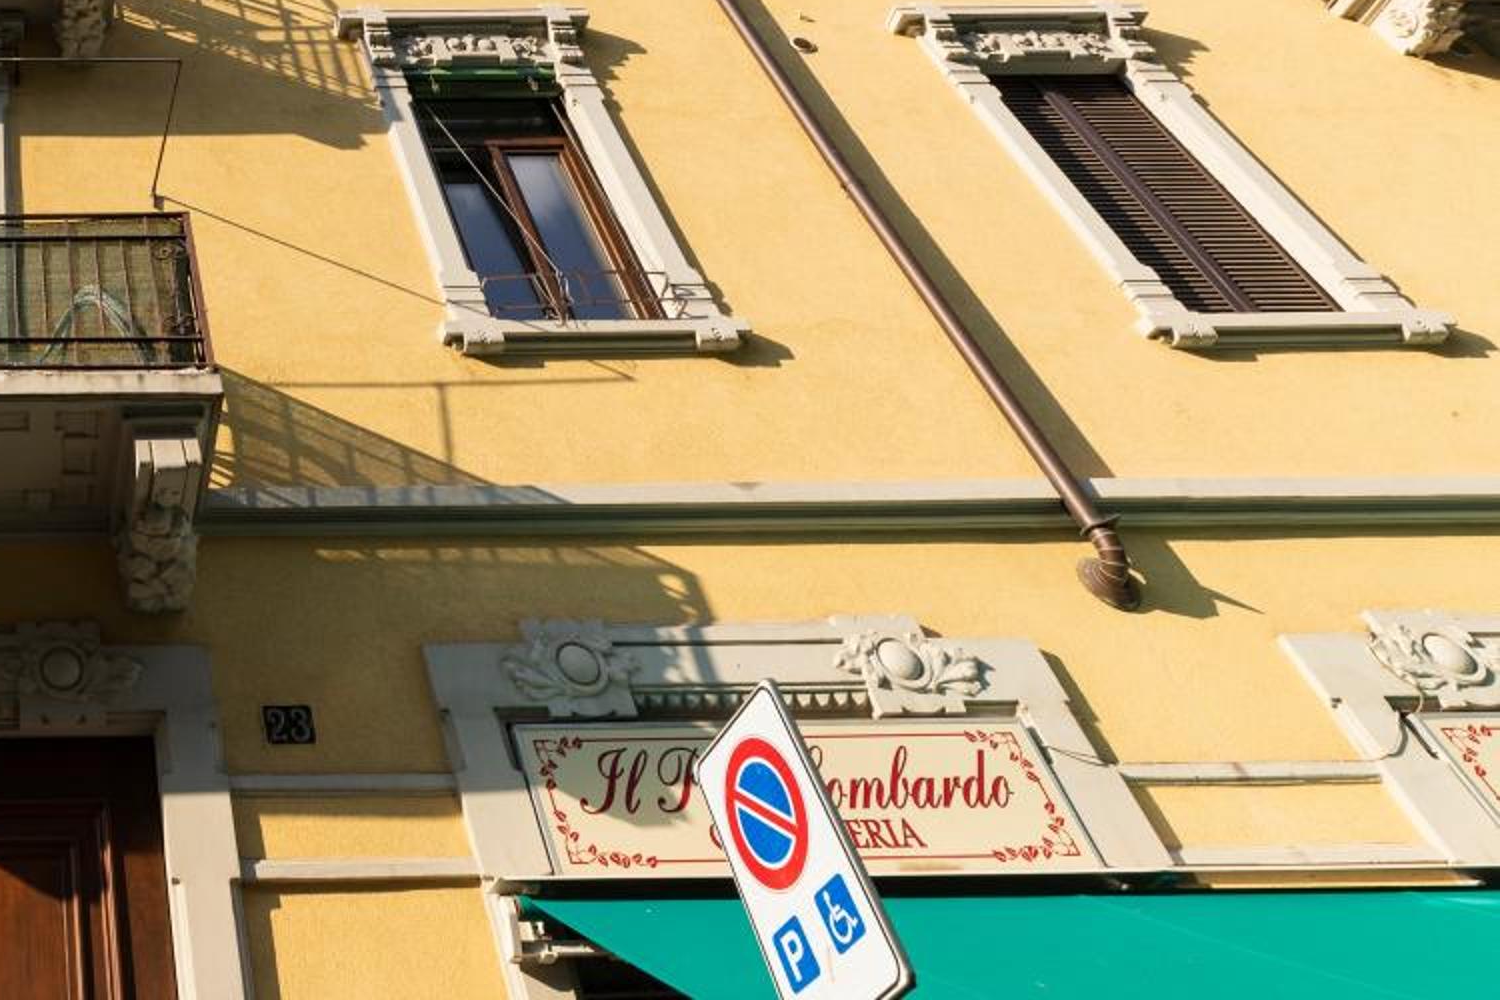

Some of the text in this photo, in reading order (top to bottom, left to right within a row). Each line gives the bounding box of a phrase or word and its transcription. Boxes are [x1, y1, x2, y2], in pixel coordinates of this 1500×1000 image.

[267, 708, 311, 741] 23
[580, 747, 648, 814] Il
[809, 745, 1014, 809] ombardo
[779, 929, 804, 982] P
